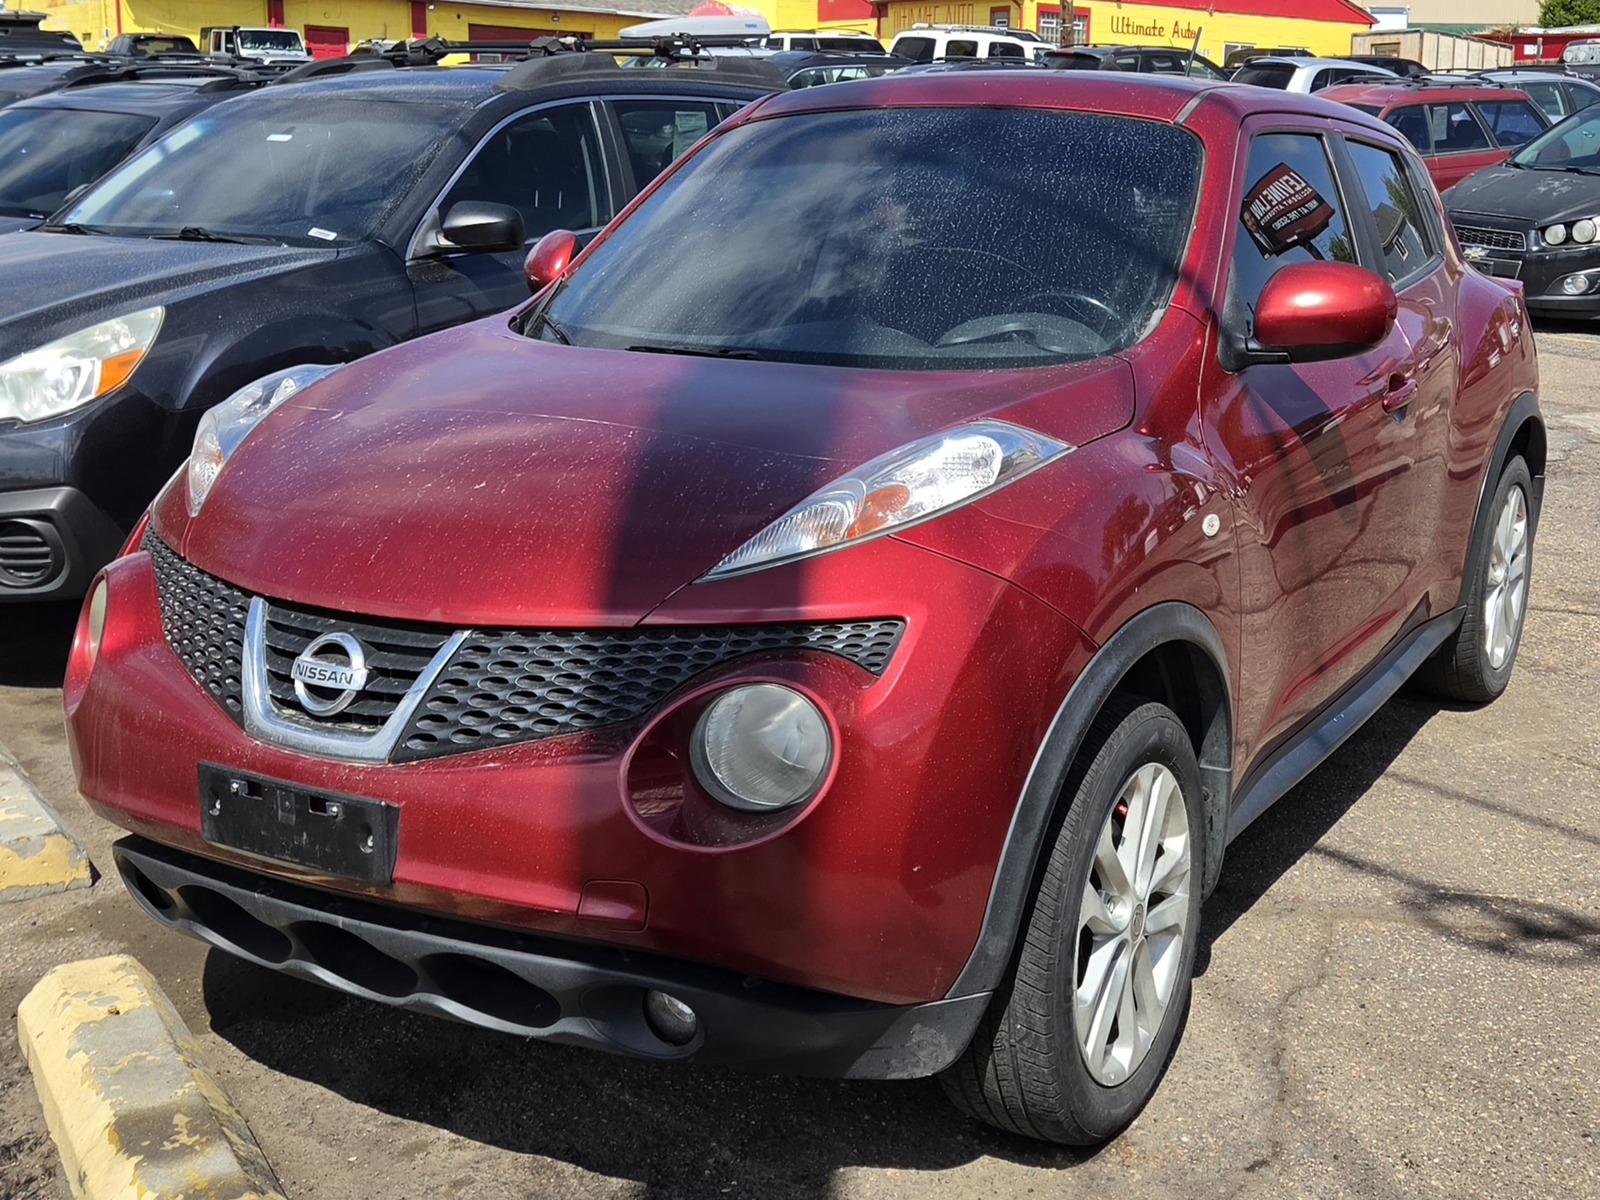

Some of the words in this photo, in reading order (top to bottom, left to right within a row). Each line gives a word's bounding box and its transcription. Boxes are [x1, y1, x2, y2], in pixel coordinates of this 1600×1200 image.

[1110, 15, 1165, 37] Ultimate
[1172, 20, 1197, 39] Auto
[295, 663, 354, 685] NISSAN
